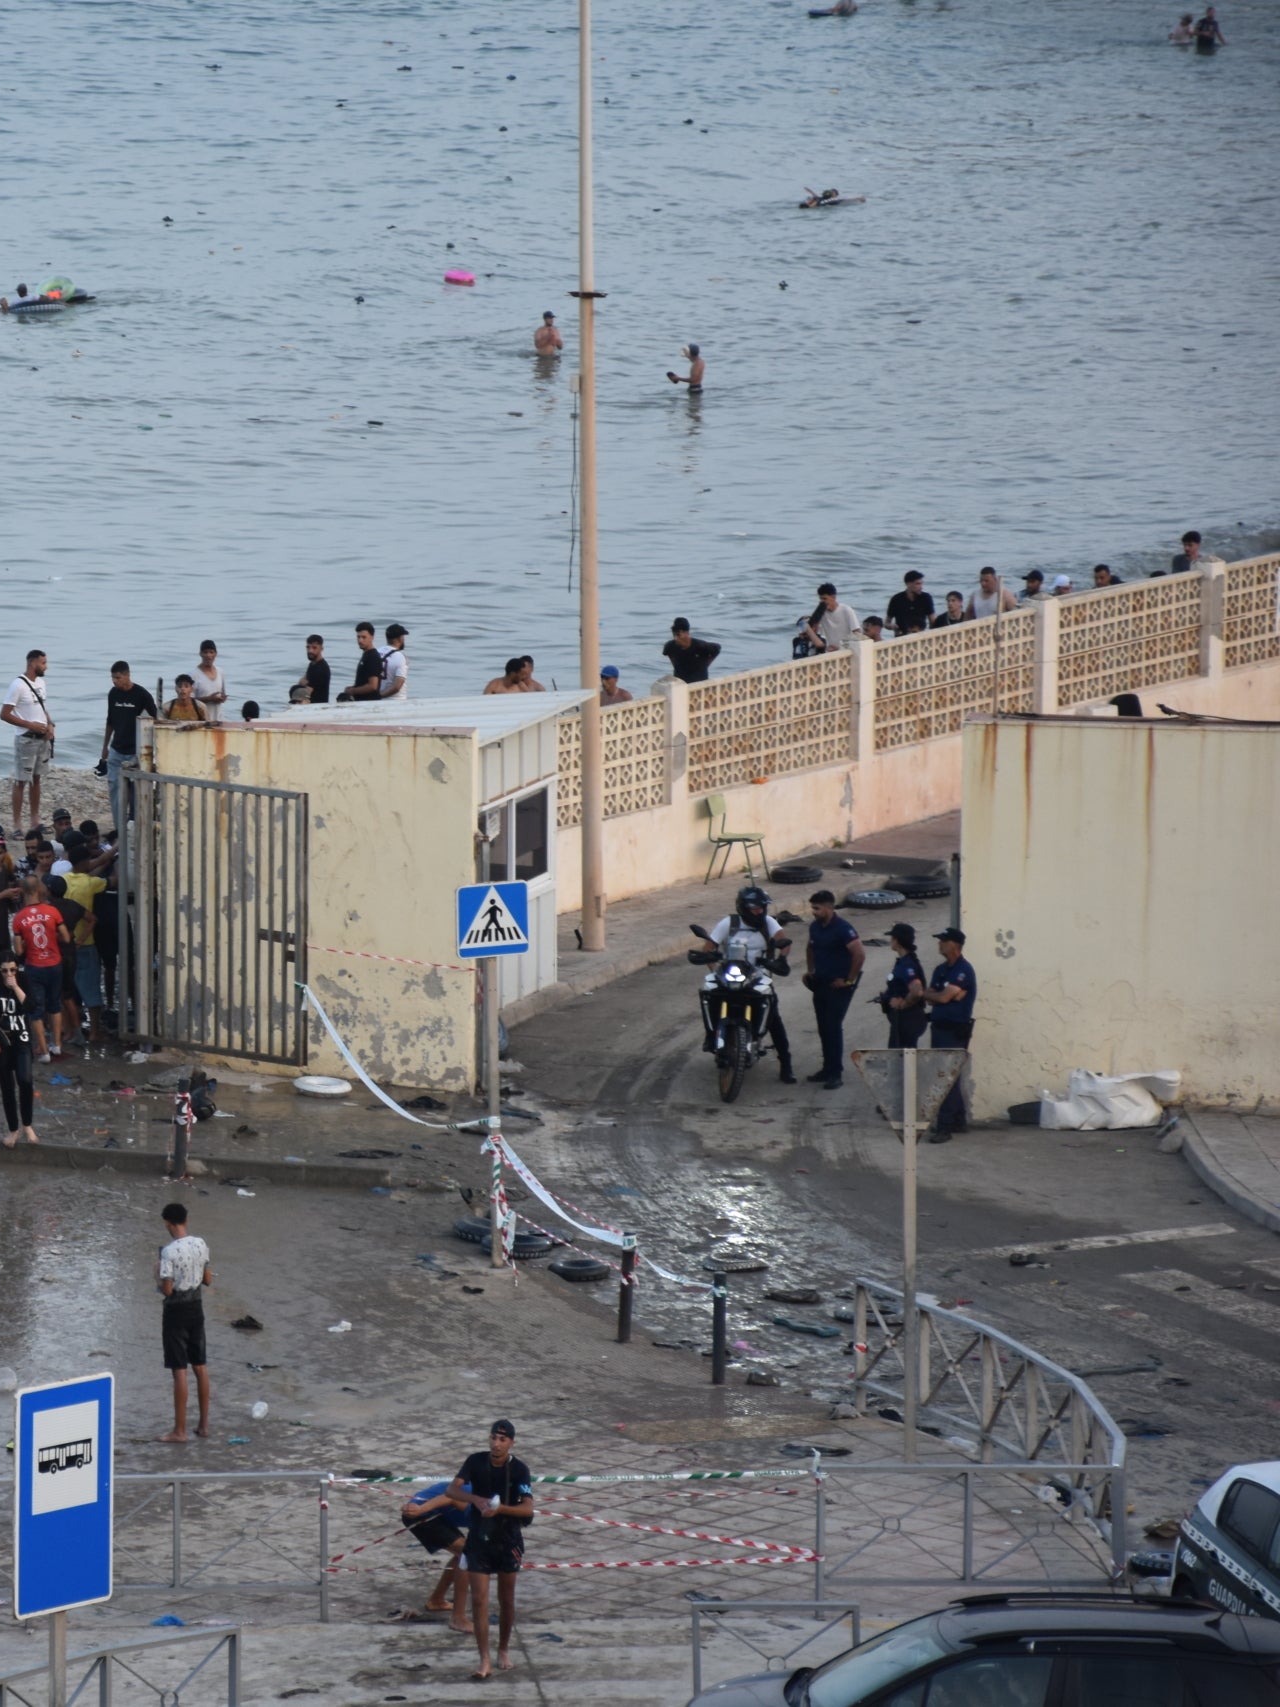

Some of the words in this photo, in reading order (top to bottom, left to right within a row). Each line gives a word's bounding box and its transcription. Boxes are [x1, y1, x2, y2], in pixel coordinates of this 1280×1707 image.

[31, 923, 48, 949] 8
[9, 1014, 26, 1031] KY
[1209, 1579, 1246, 1614] GUARDIA
